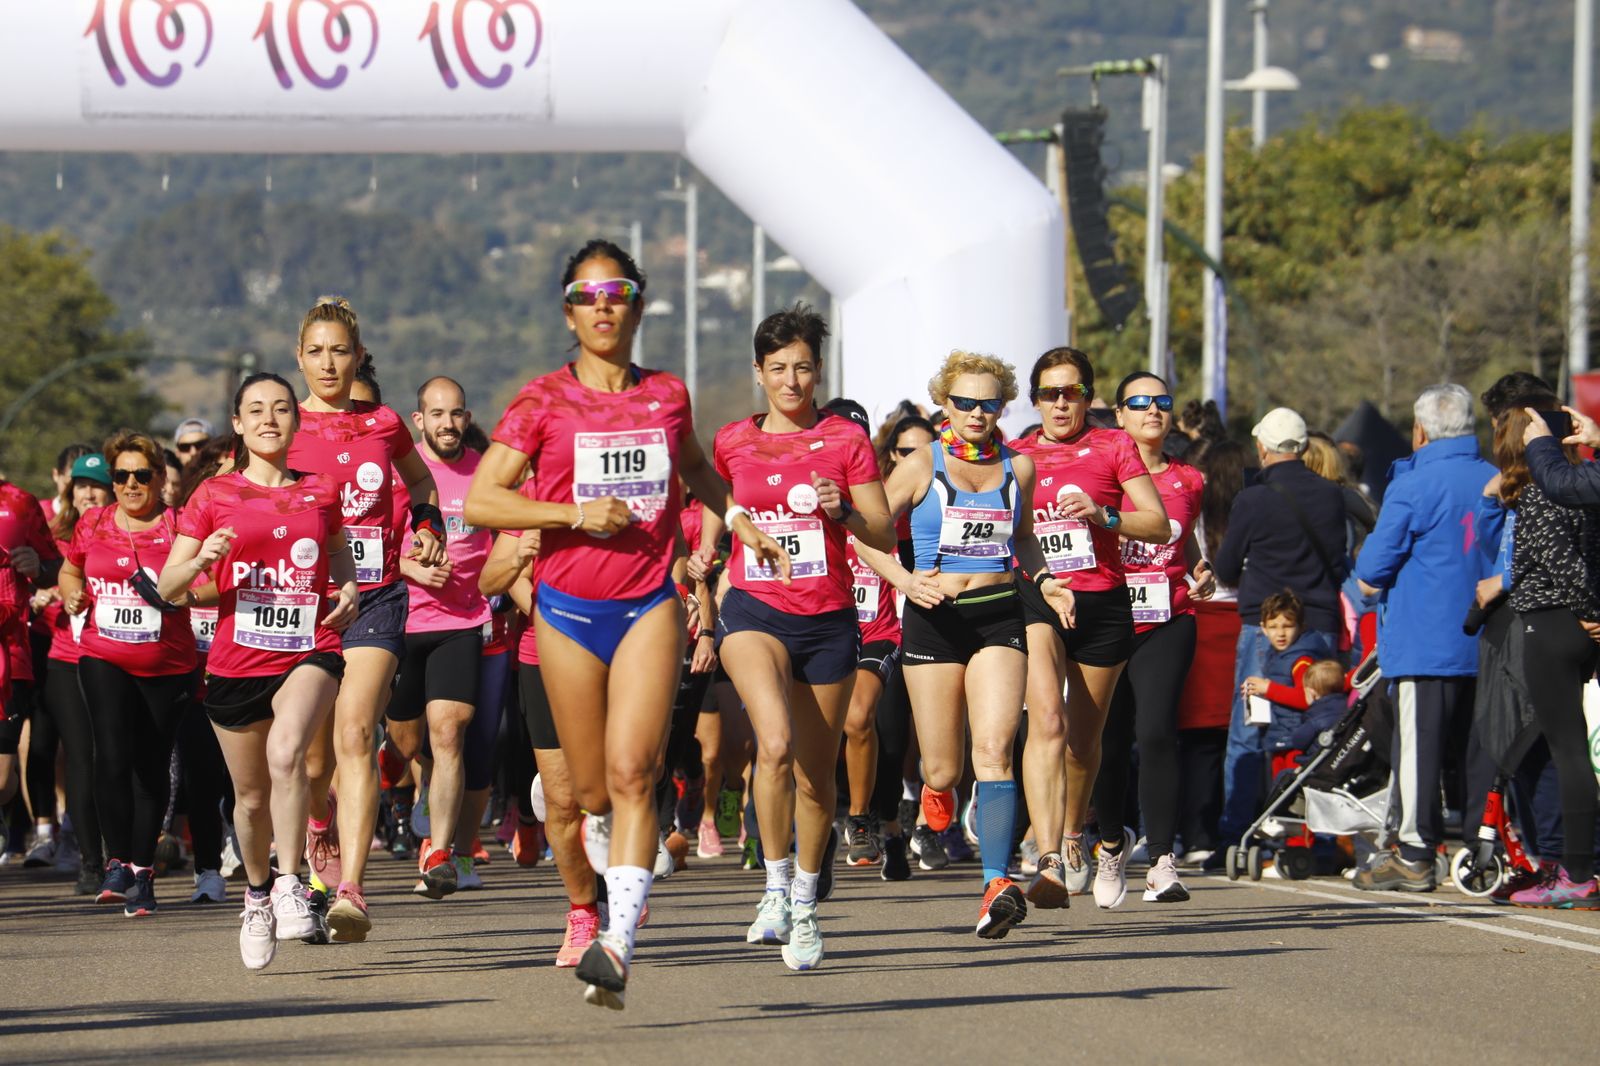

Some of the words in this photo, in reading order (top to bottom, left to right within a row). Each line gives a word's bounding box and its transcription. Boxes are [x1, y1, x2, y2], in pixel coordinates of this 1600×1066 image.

[600, 448, 646, 475] 1119
[961, 521, 995, 540] 243
[1040, 533, 1073, 554] 494
[232, 558, 297, 588] Pink
[114, 608, 143, 625] 708
[253, 606, 300, 629] 1094
[1330, 727, 1367, 770] MACLAREN
